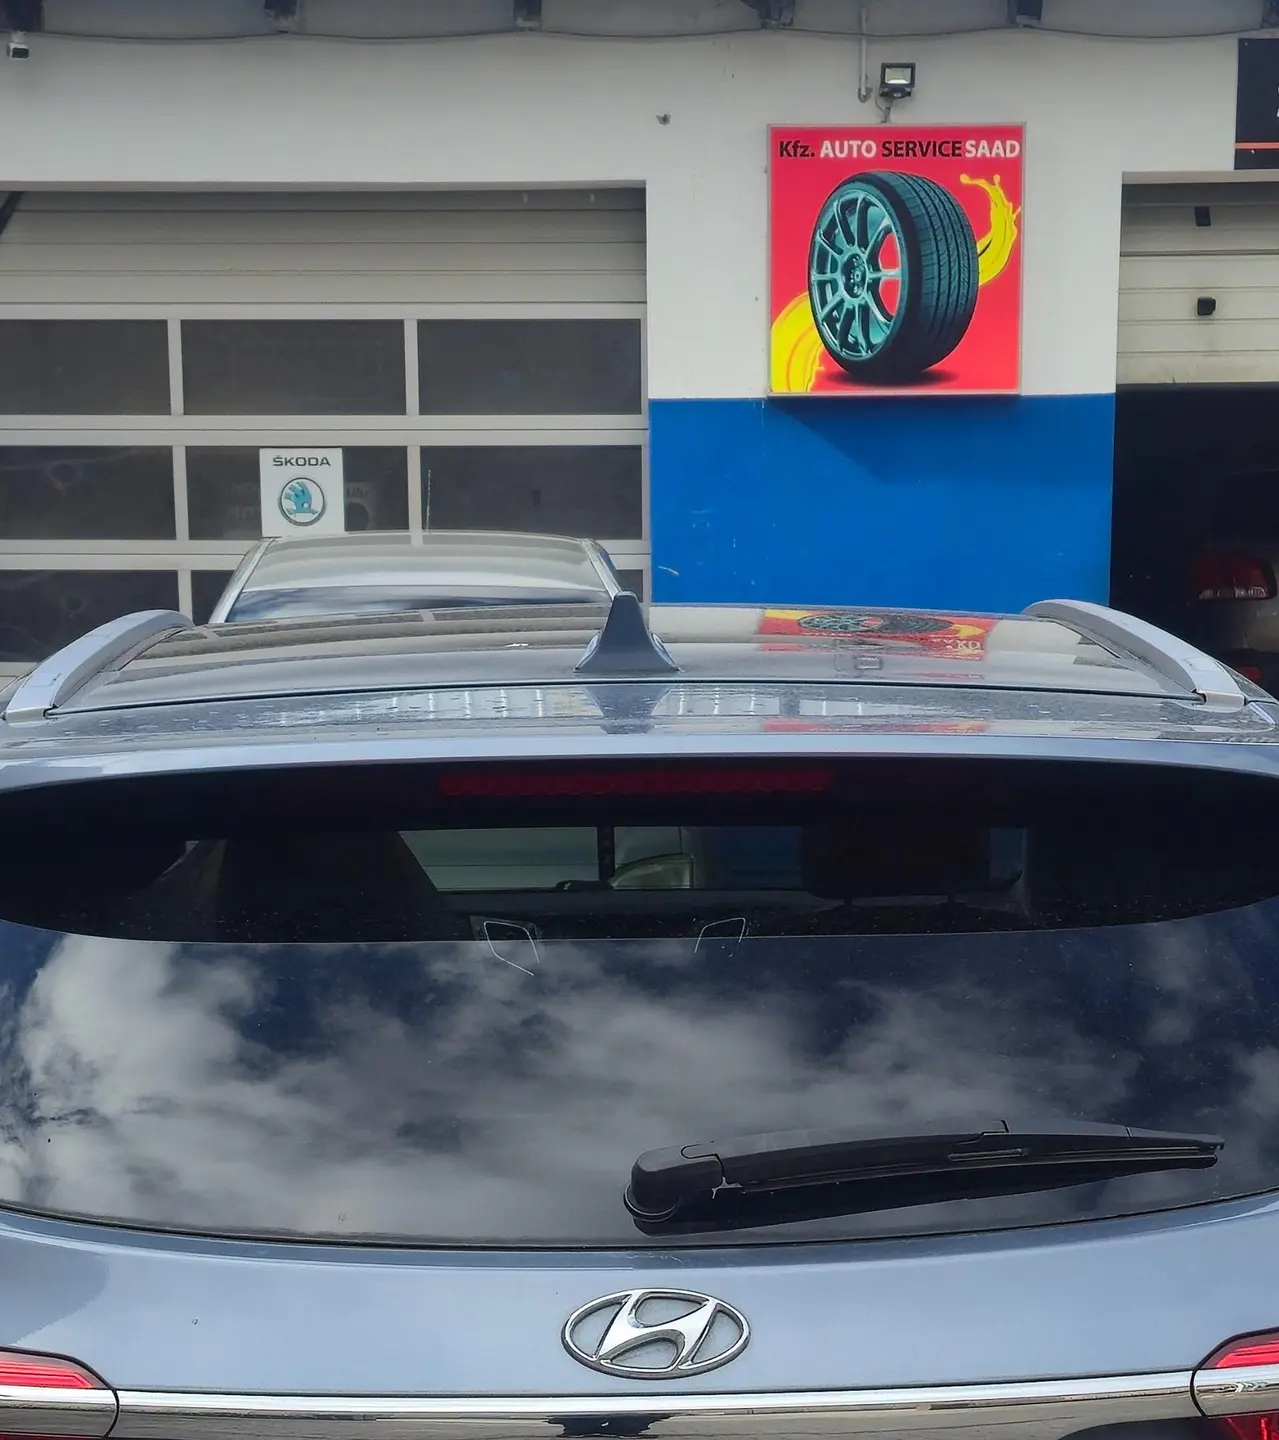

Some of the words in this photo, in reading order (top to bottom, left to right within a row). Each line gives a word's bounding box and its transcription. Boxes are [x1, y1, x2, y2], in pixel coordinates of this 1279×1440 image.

[779, 139, 815, 158] Kfz.
[820, 139, 877, 158] AUTO
[881, 139, 963, 158] SERVICE
[964, 139, 1021, 158] SAAD
[272, 455, 332, 467] ŠKODA
